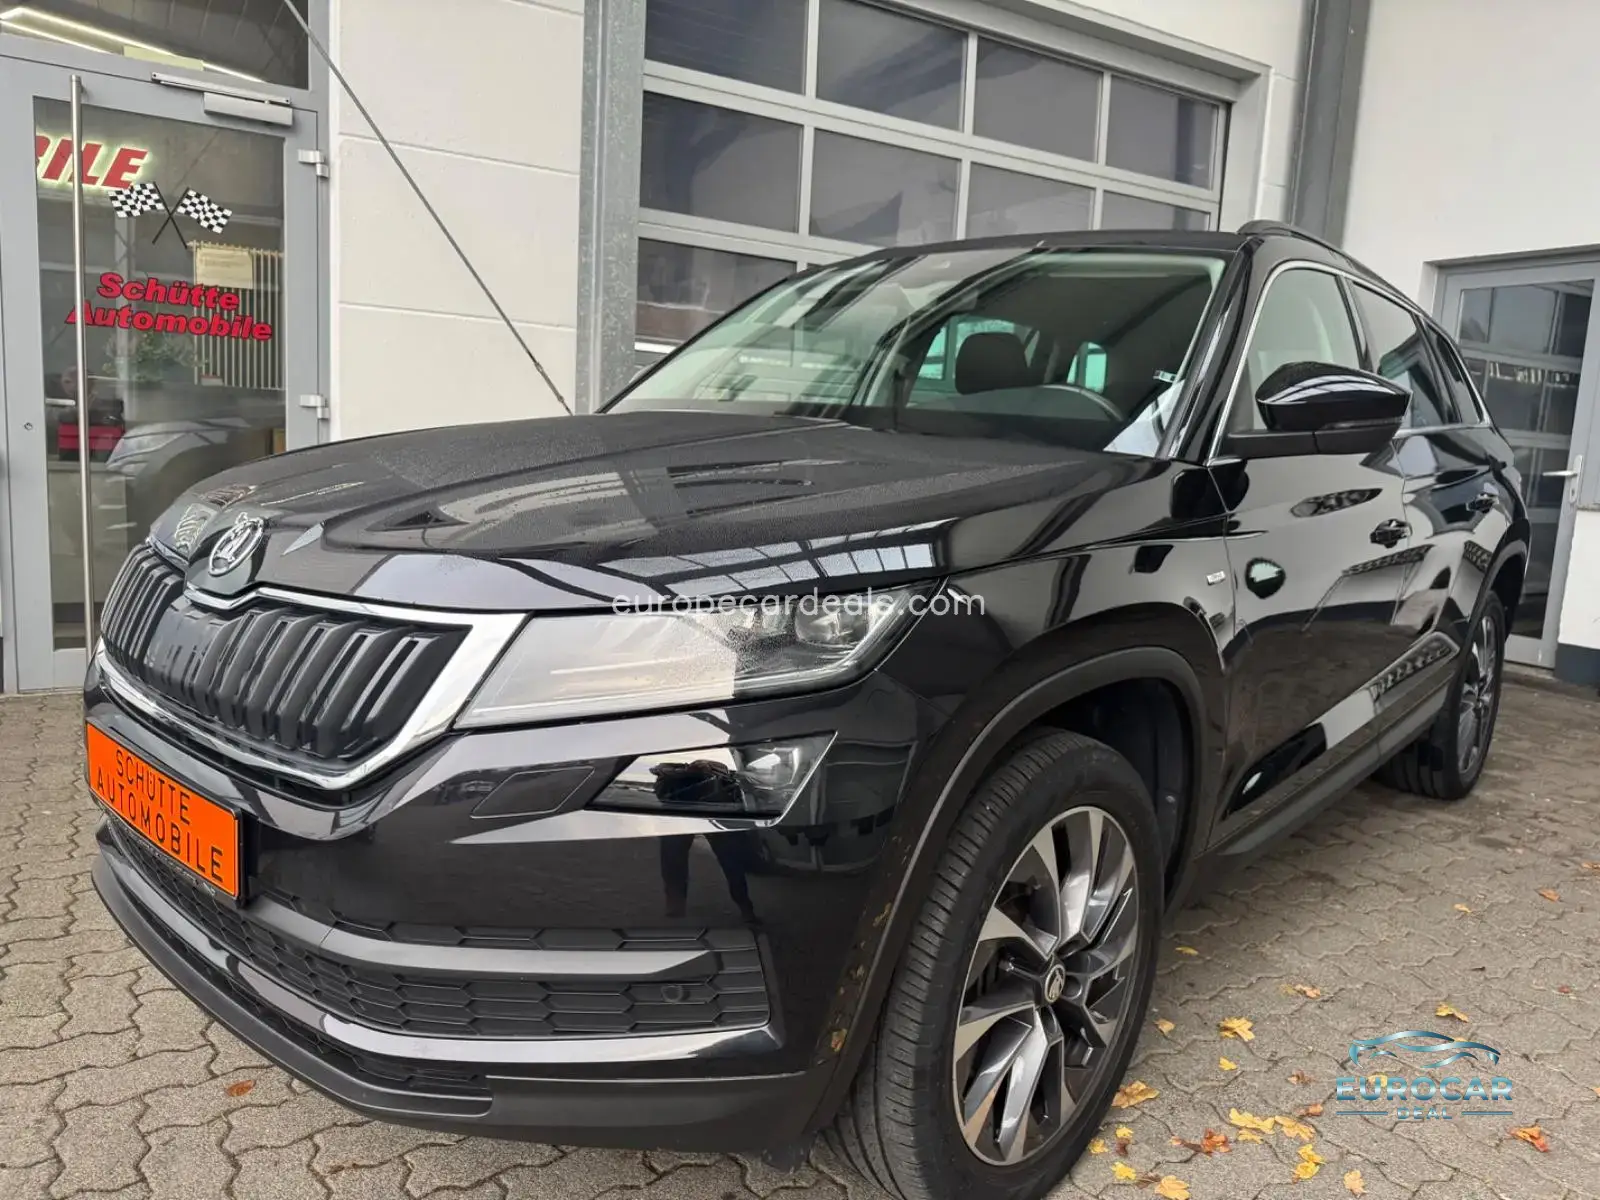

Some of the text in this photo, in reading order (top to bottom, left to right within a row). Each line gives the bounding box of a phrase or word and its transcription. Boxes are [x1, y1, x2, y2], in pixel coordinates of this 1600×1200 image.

[97, 272, 240, 310] Schütte
[65, 300, 273, 340] Automobile
[116, 750, 190, 825] SCHÜTTE
[97, 767, 223, 882] AUTOMOBILE
